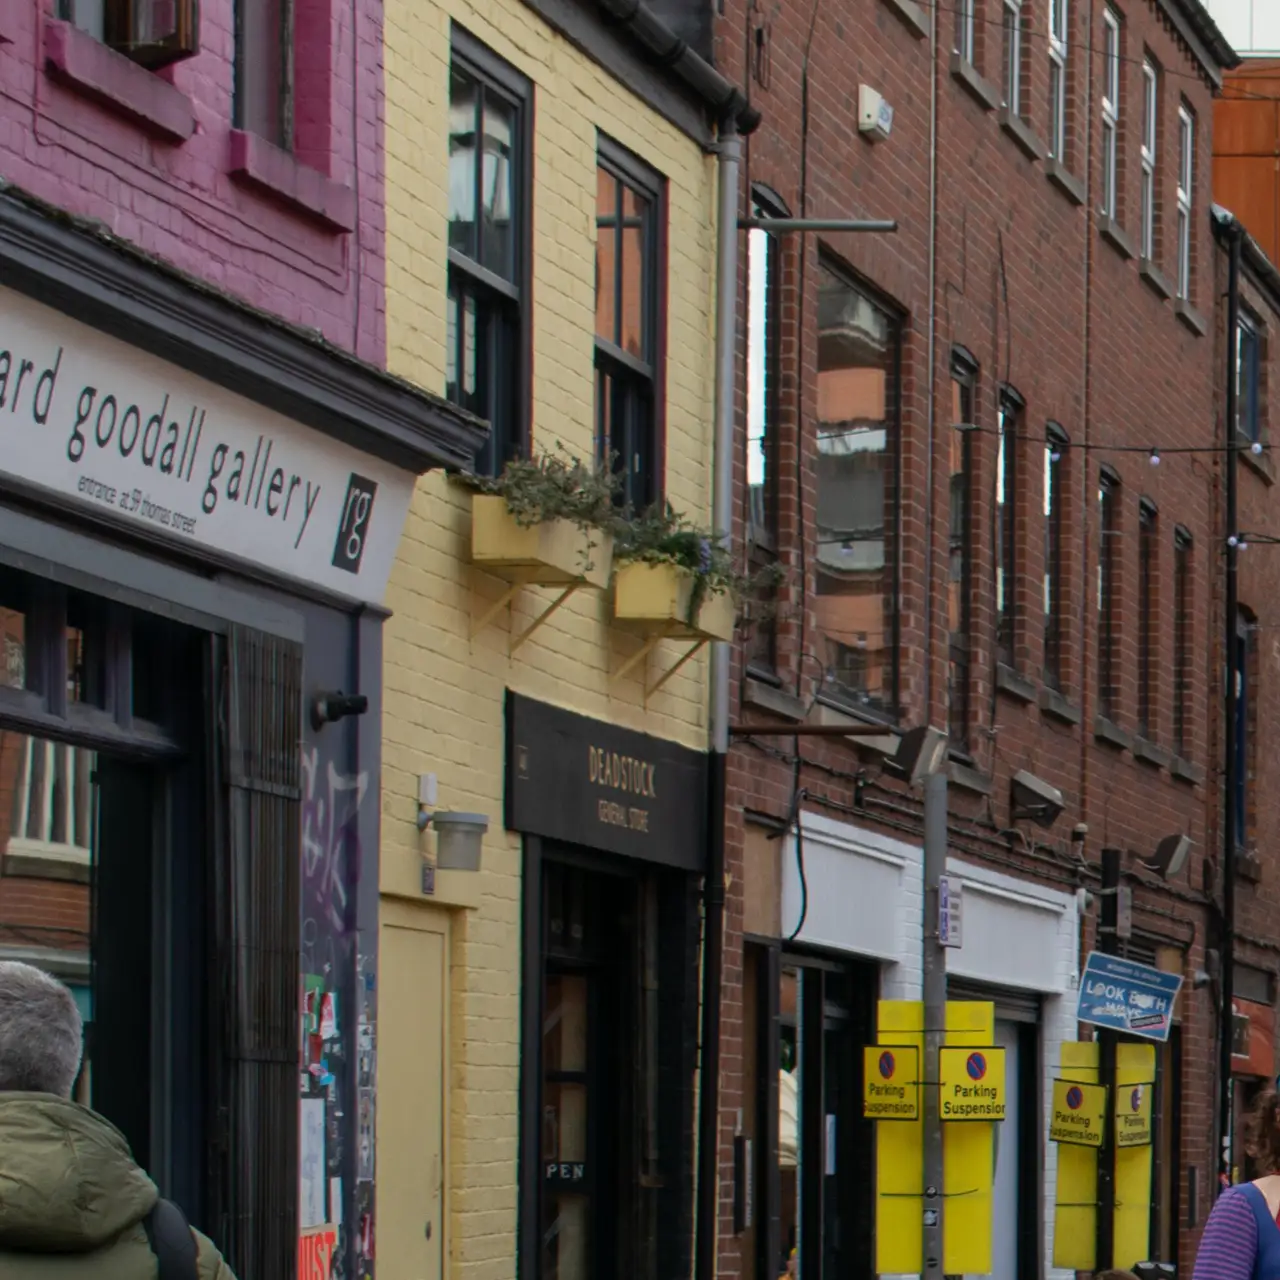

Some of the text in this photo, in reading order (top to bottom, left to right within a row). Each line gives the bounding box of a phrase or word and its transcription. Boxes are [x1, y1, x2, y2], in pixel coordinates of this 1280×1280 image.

[67, 385, 206, 482] goodall
[202, 435, 321, 549] gallery
[589, 744, 657, 798] DEADSTOCK
[1129, 990, 1166, 1011] BTH
[869, 1082, 905, 1098] Parking
[954, 1084, 998, 1099] Parking
[1056, 1111, 1090, 1128] Parking
